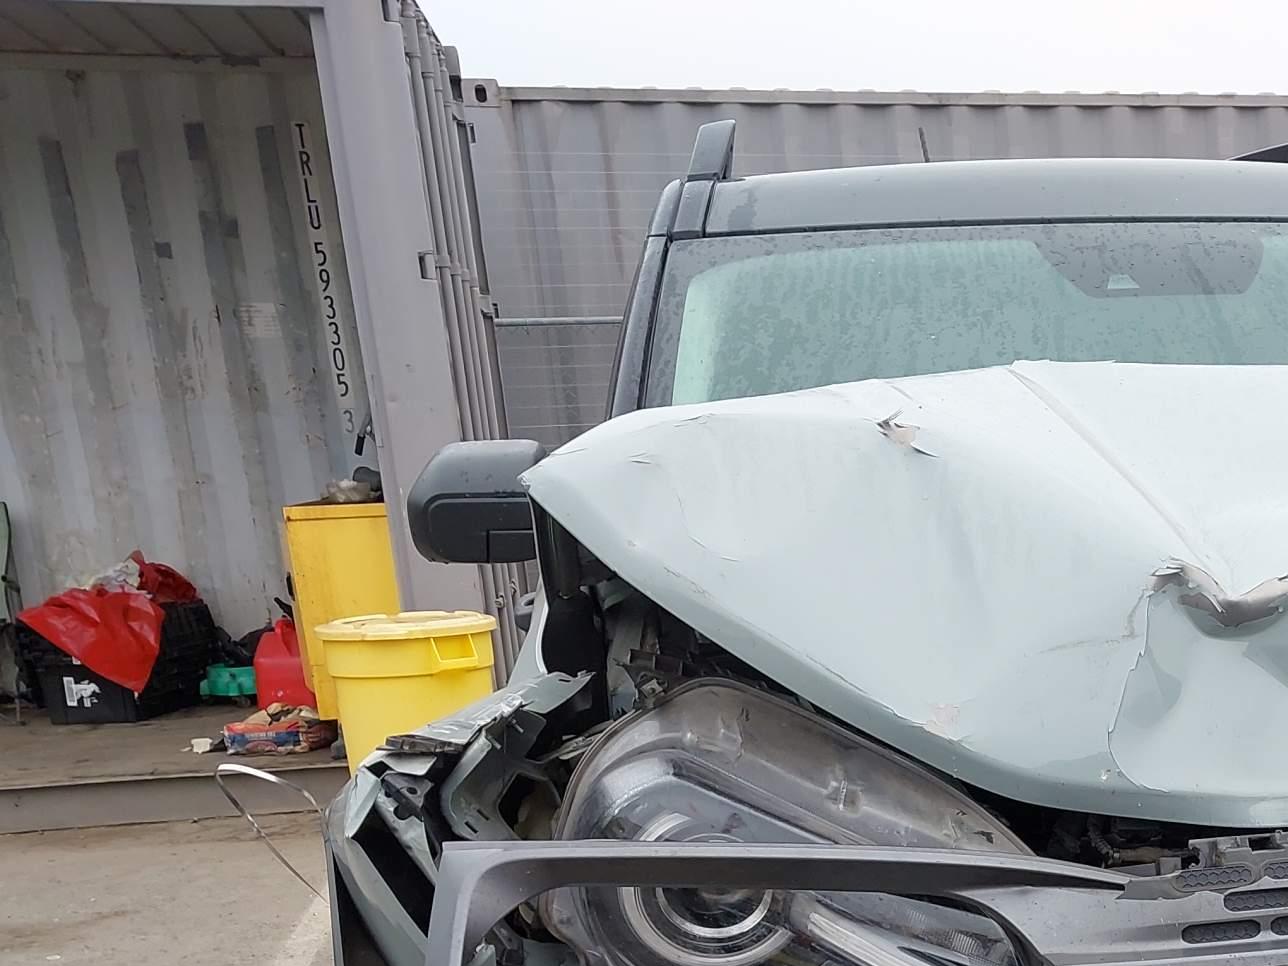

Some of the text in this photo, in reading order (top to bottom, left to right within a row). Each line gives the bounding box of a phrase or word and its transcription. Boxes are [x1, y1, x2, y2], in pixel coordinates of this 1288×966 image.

[294, 123, 355, 433] TRLU 593305 3
